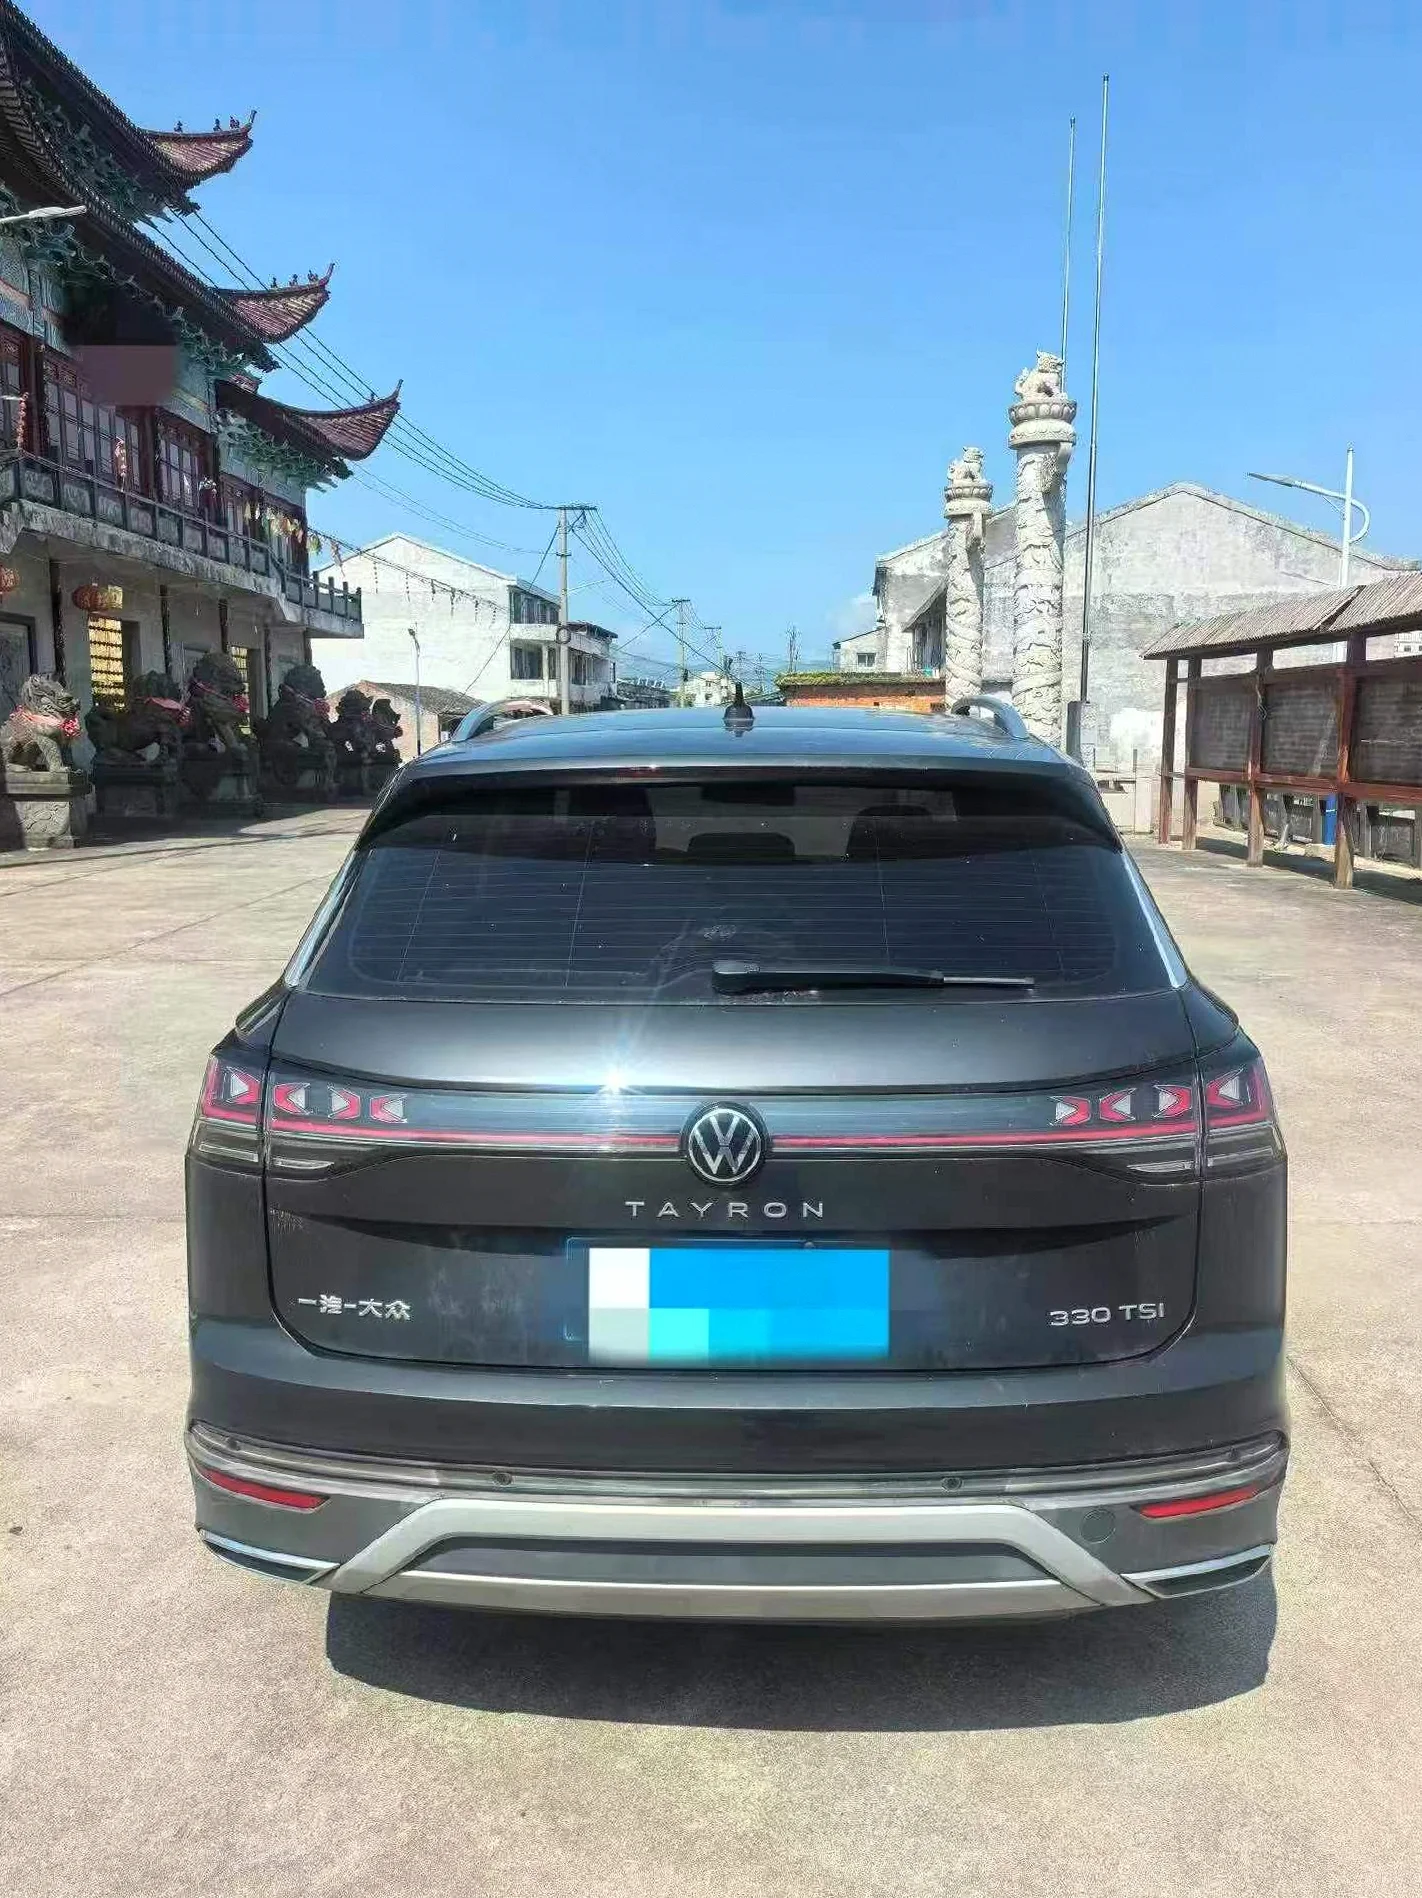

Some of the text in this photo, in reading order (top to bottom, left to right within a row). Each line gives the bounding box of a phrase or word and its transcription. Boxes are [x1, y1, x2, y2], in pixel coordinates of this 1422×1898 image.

[625, 1201, 824, 1218] TAYRON
[1049, 1302, 1165, 1326] 330 TSI
